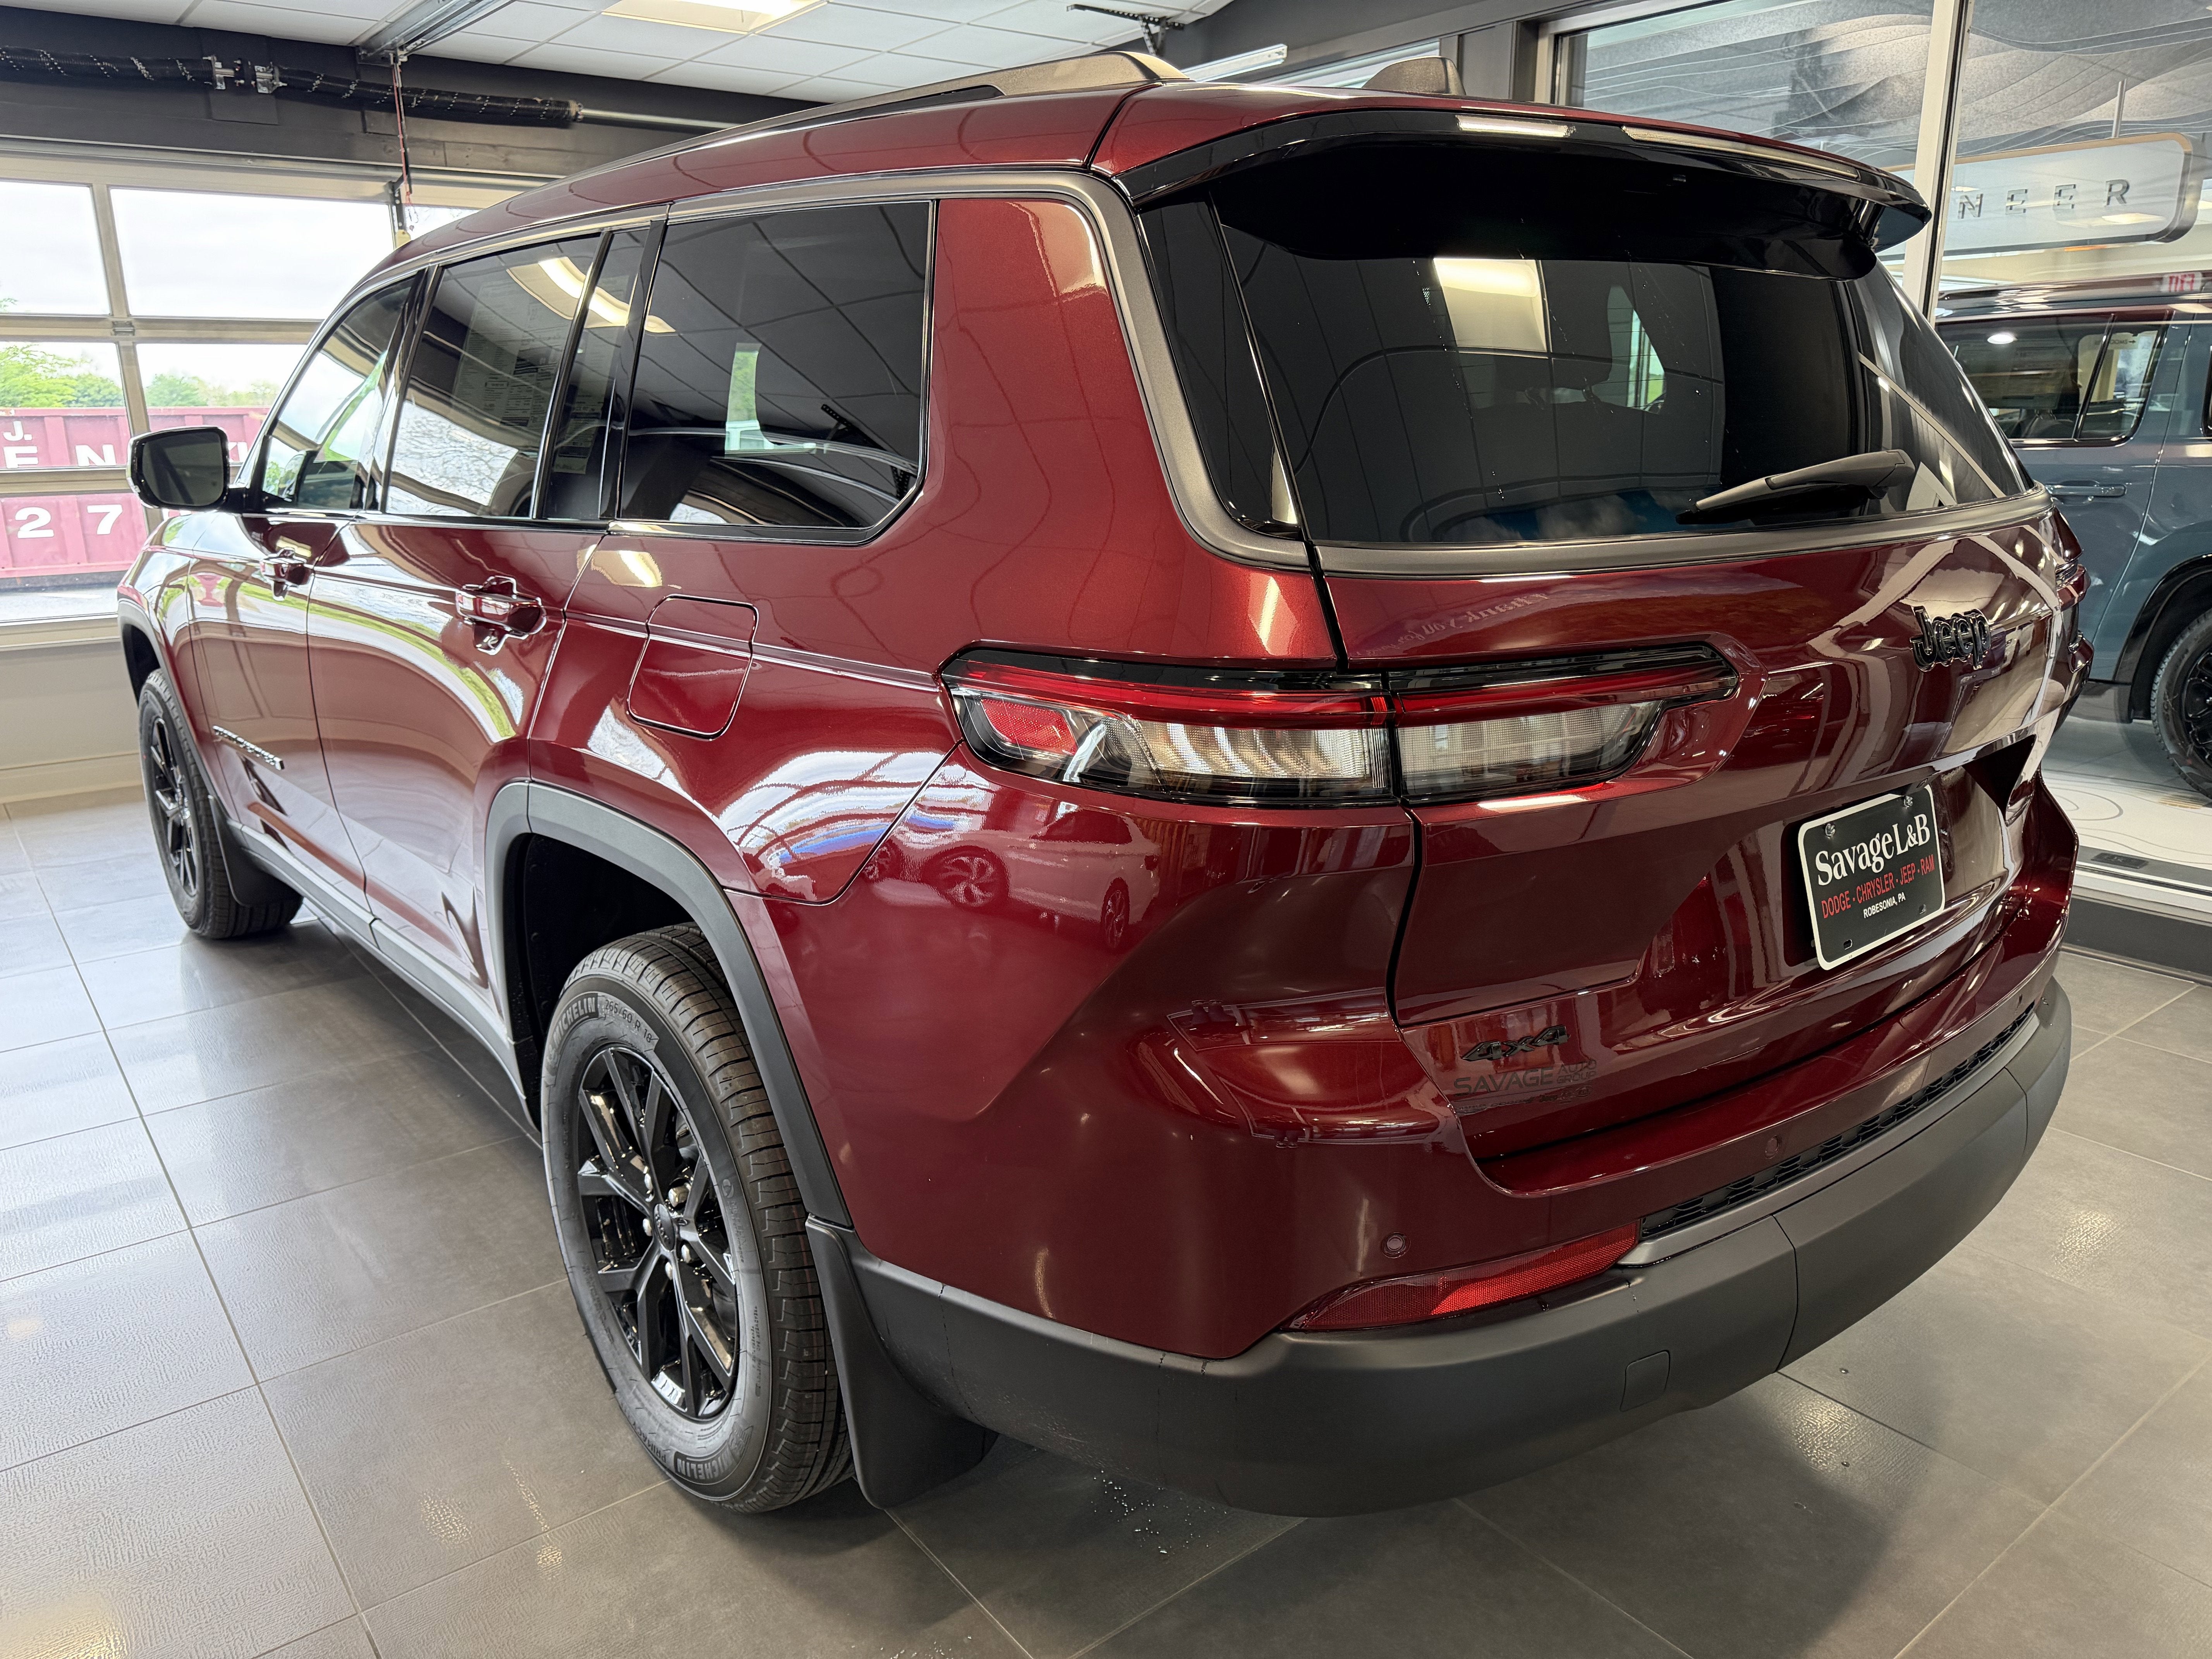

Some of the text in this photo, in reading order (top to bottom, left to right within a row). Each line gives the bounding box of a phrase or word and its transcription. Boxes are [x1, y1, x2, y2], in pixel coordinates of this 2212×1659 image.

[3, 421, 33, 441] J.
[1910, 606, 1991, 672] Jeep
[1821, 890, 1851, 919] DODGE
[1856, 872, 1895, 903] CHRYSLER
[1900, 863, 1916, 885] JEEP
[1920, 854, 1935, 875] RAM
[1863, 892, 1906, 919] ROBESONIA, PA
[553, 997, 596, 1047] MICHELIN
[634, 1020, 641, 1031] R
[644, 1029, 652, 1043] 18
[1461, 1024, 1570, 1061] 4x4
[1454, 1066, 1554, 1097] SAVAGE
[1556, 1071, 1597, 1084] GROUP
[1558, 1059, 1597, 1075] AUTO
[632, 1421, 666, 1463] PRIMACY
[677, 1448, 735, 1480] MICHELIN
